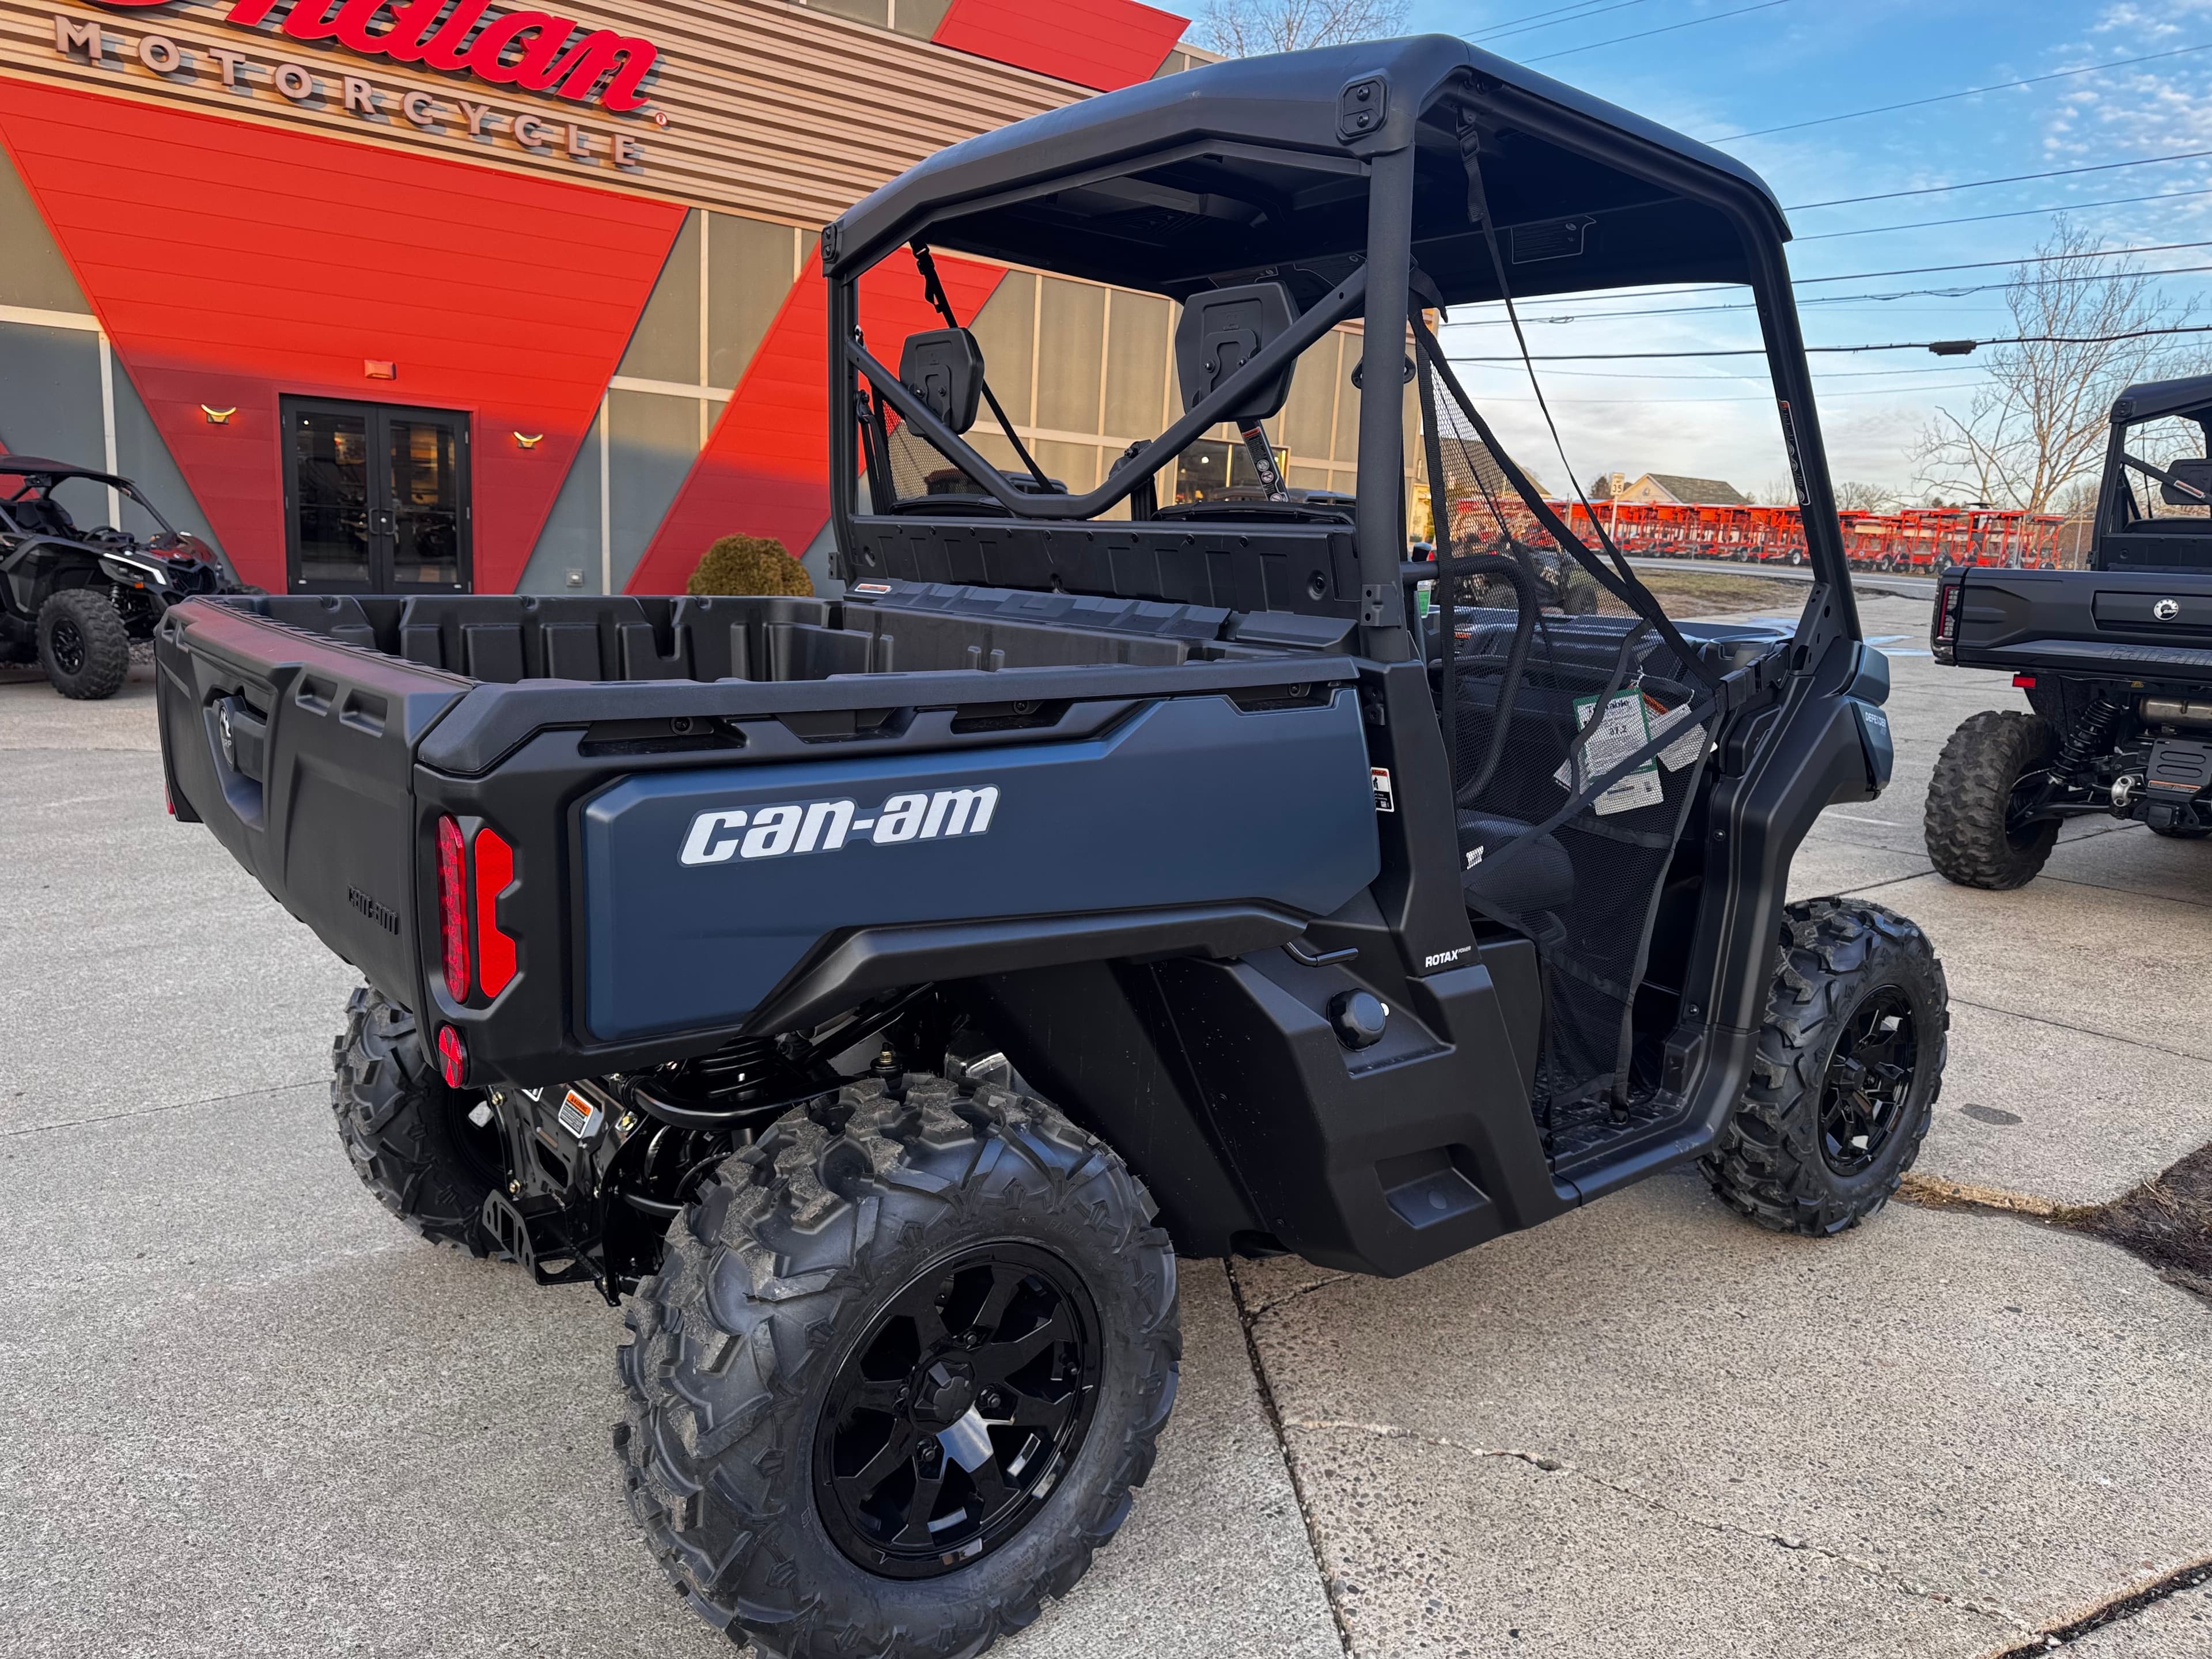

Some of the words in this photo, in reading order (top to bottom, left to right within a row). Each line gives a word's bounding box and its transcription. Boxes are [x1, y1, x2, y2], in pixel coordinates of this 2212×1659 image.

[55, 16, 636, 166] MOTORCYCLE
[1612, 484, 1623, 493] 35
[1865, 711, 1886, 728] DEFENDER
[681, 787, 999, 865] can-am
[347, 884, 398, 935] can-am
[1425, 949, 1459, 968] ROTAX
